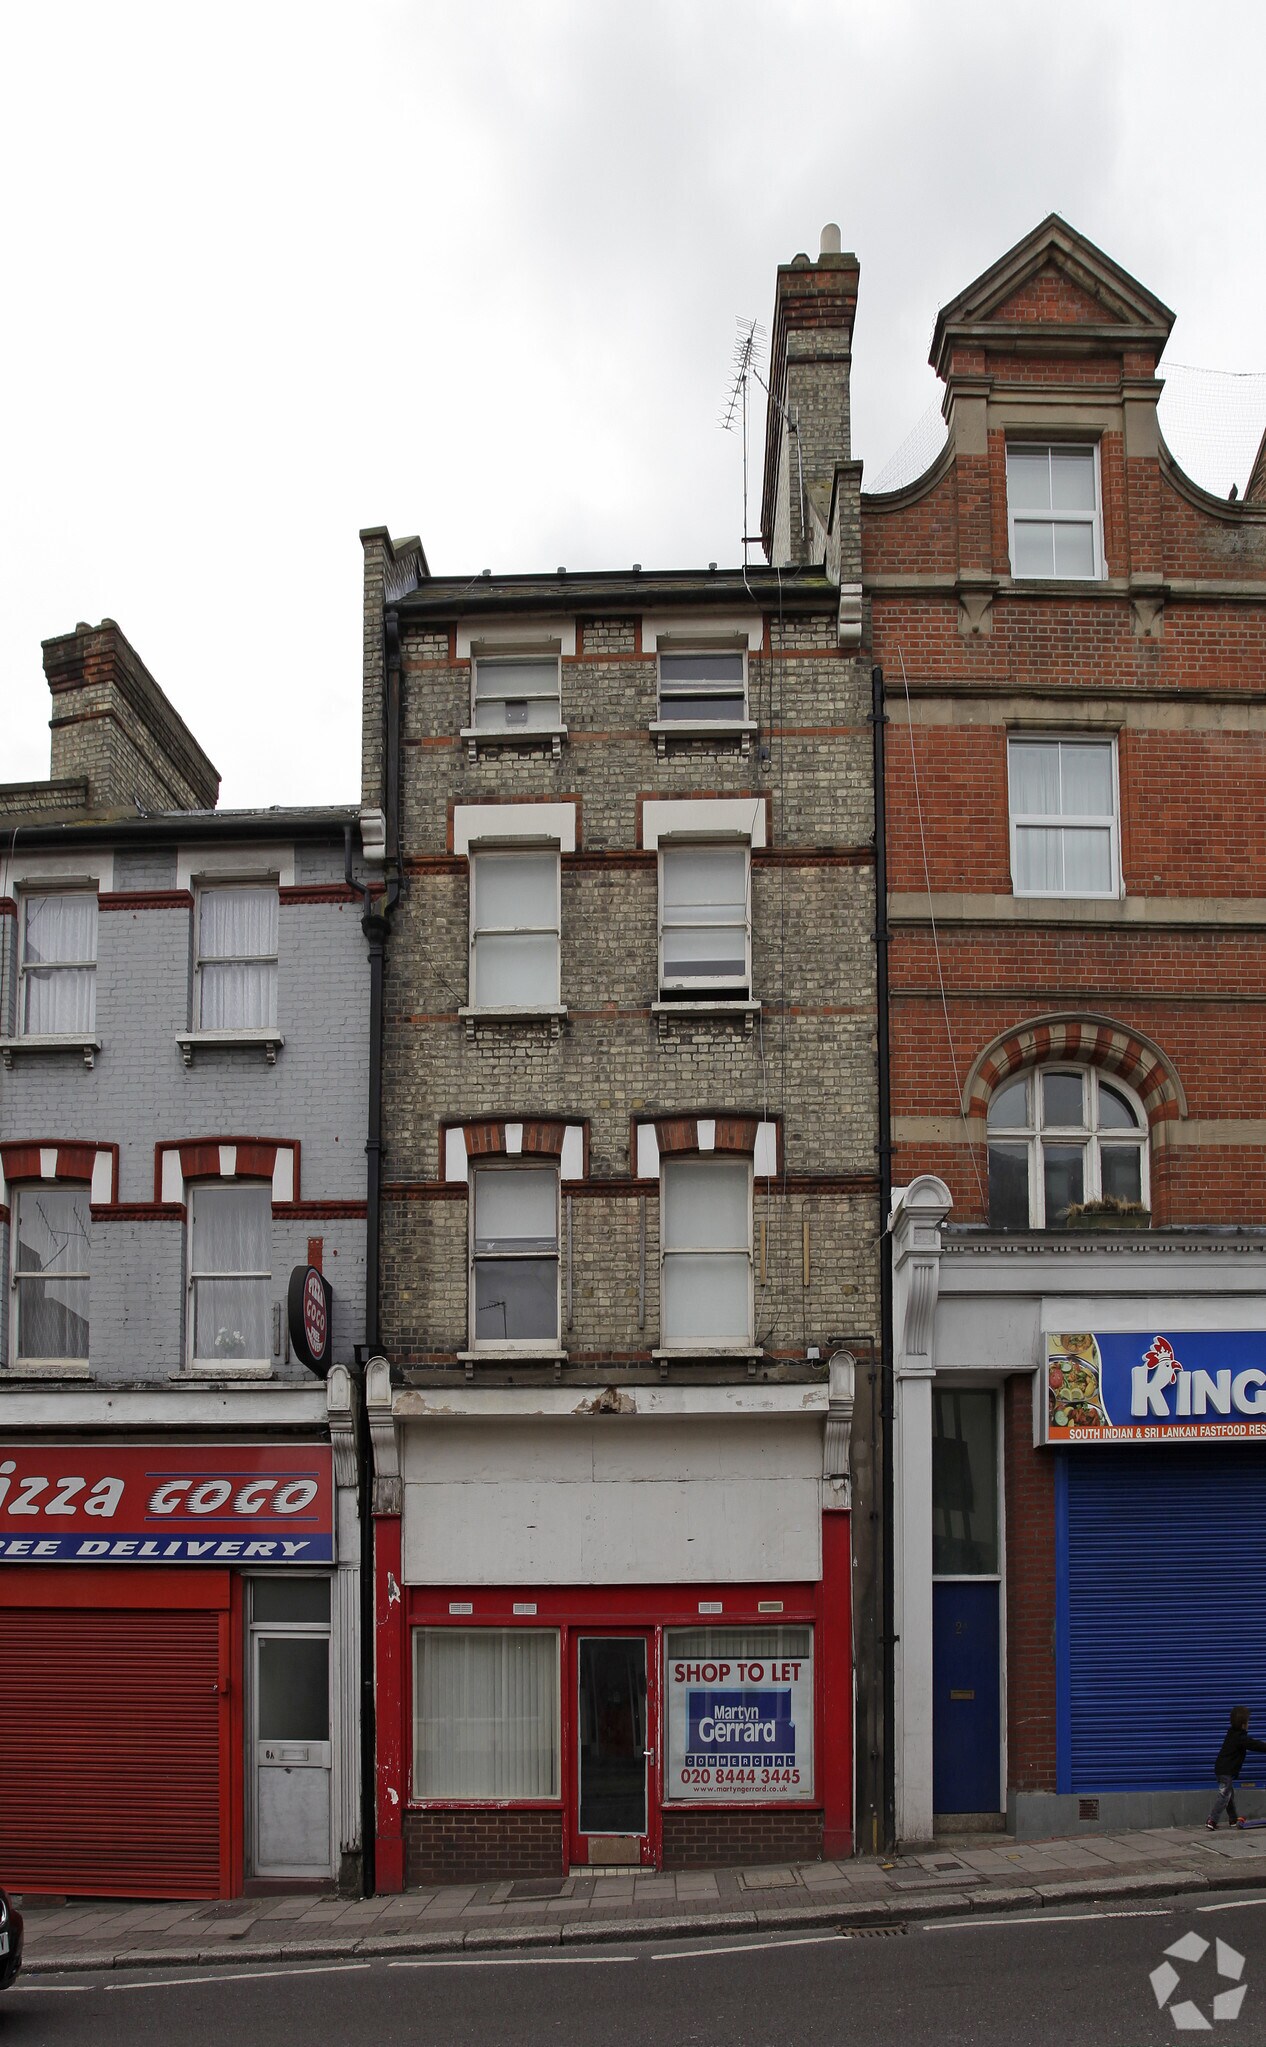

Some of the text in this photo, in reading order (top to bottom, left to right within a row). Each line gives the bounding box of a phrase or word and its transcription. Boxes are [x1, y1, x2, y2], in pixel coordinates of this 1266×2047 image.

[308, 1277, 324, 1308] PIZZA
[1069, 1428, 1100, 1440] SOUTH
[1102, 1427, 1133, 1439] INDIAN
[1135, 1427, 1143, 1438] &
[1144, 1427, 1159, 1438] SRI
[1161, 1426, 1198, 1438] LANKAN
[1200, 1424, 1247, 1437] FASTFOOD
[145, 1479, 319, 1514] GOGO
[75, 1540, 311, 1556] DELIVERY
[674, 1663, 802, 1682] SHOP TO LET
[714, 1705, 759, 1721] Martyn
[698, 1717, 776, 1743] Gerrard
[686, 1756, 794, 1766] COMMERCIAL
[681, 1769, 801, 1784] 020 8444 3445
[693, 1785, 788, 1794] www.martyngerrard.co.uk
